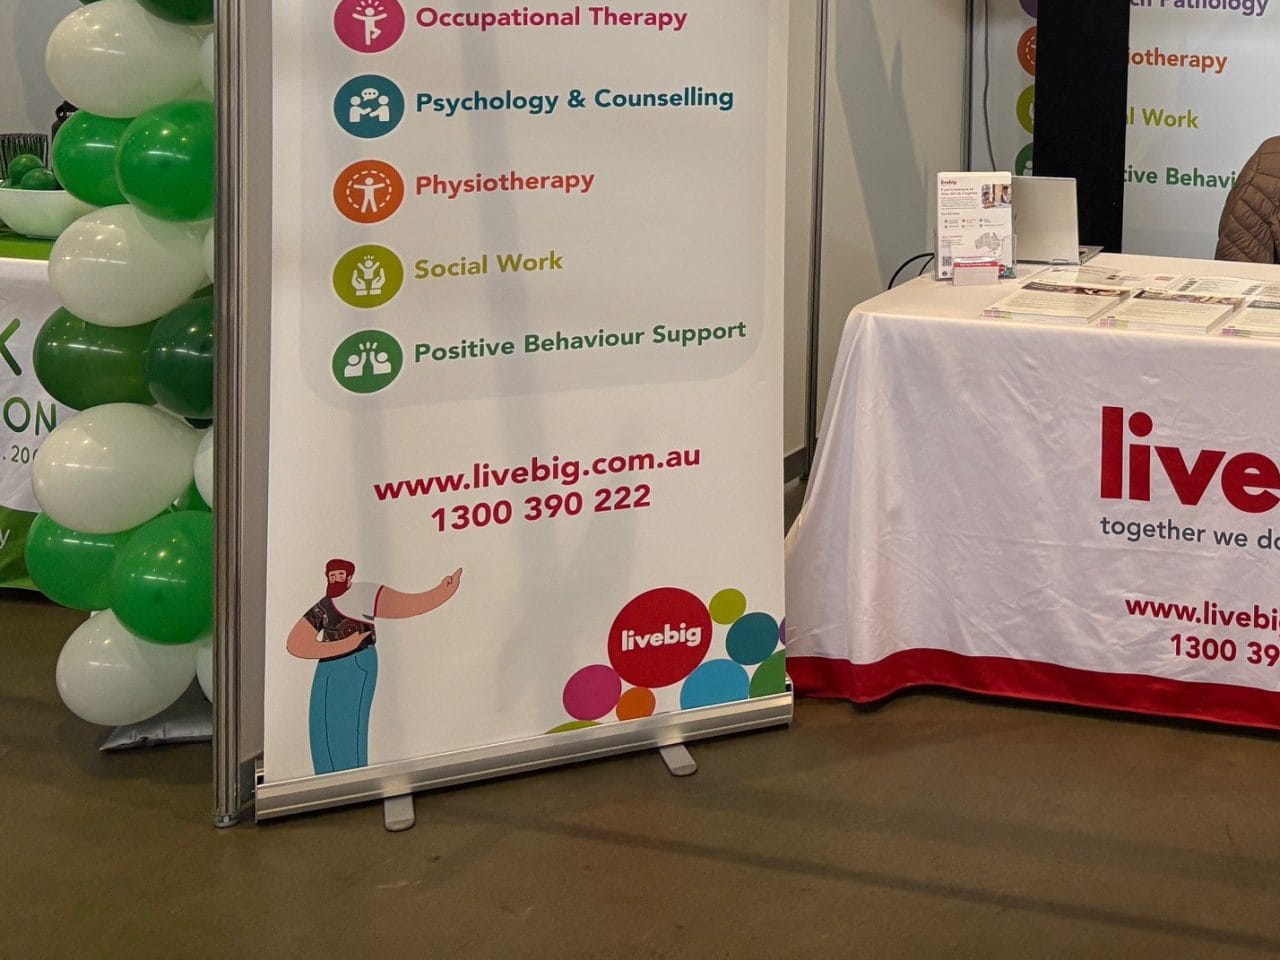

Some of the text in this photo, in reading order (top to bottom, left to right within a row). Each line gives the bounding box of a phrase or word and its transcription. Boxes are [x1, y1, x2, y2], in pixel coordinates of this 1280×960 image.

[416, 6, 688, 31] Occupational Therapy
[416, 86, 734, 118] Psychology & Counselling
[1142, 107, 1199, 129] Work
[415, 170, 595, 200] Physiotherapy
[414, 250, 563, 280] Social Work
[414, 321, 747, 363] Positive Behaviour Support
[374, 449, 701, 502] www.livebig.com.au
[430, 483, 652, 532] 1300 390 222
[1100, 517, 1206, 541] together
[1213, 530, 1248, 546] we
[621, 624, 702, 652] livebig
[1171, 634, 1237, 661] 1300
